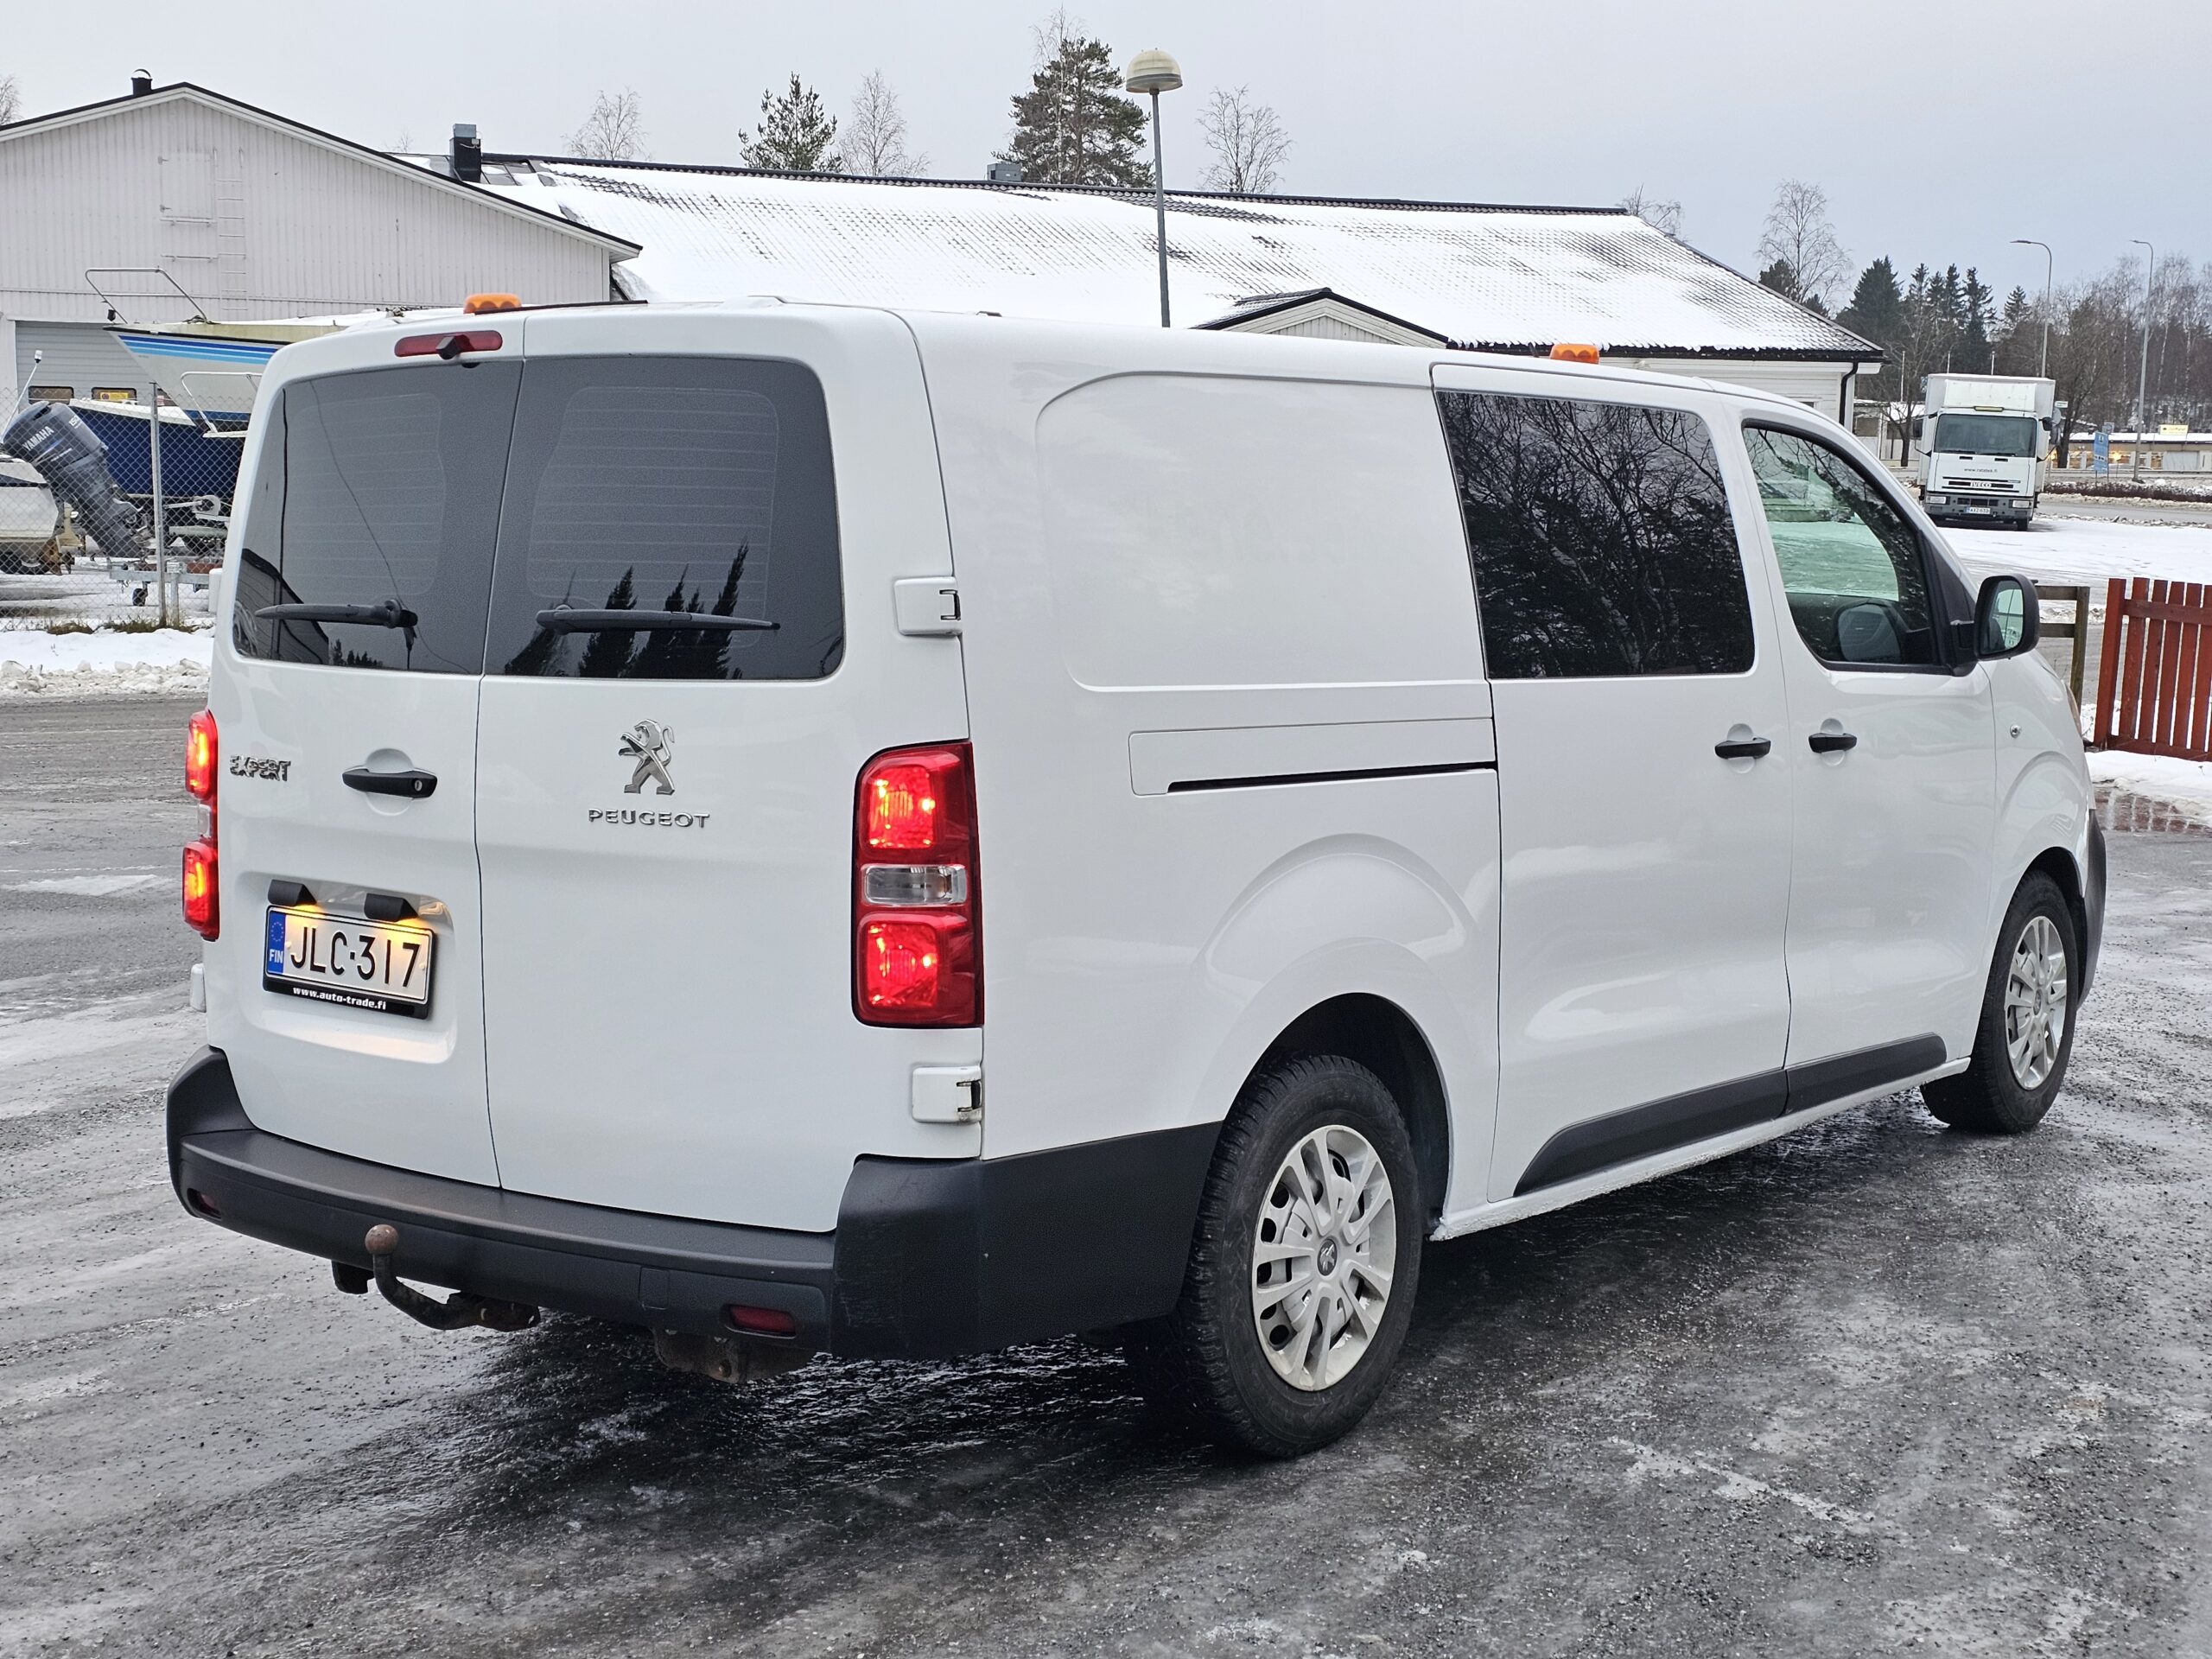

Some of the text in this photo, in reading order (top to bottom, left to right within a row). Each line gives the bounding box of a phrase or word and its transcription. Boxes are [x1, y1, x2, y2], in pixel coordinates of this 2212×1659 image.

[22, 426, 54, 451] YAMAHA
[230, 755, 291, 782] EXPERT
[588, 808, 710, 829] PEUGEOT
[269, 949, 283, 963] FIN
[290, 926, 422, 987] JLC-317
[292, 987, 386, 1010] www.auto-trade.fi
